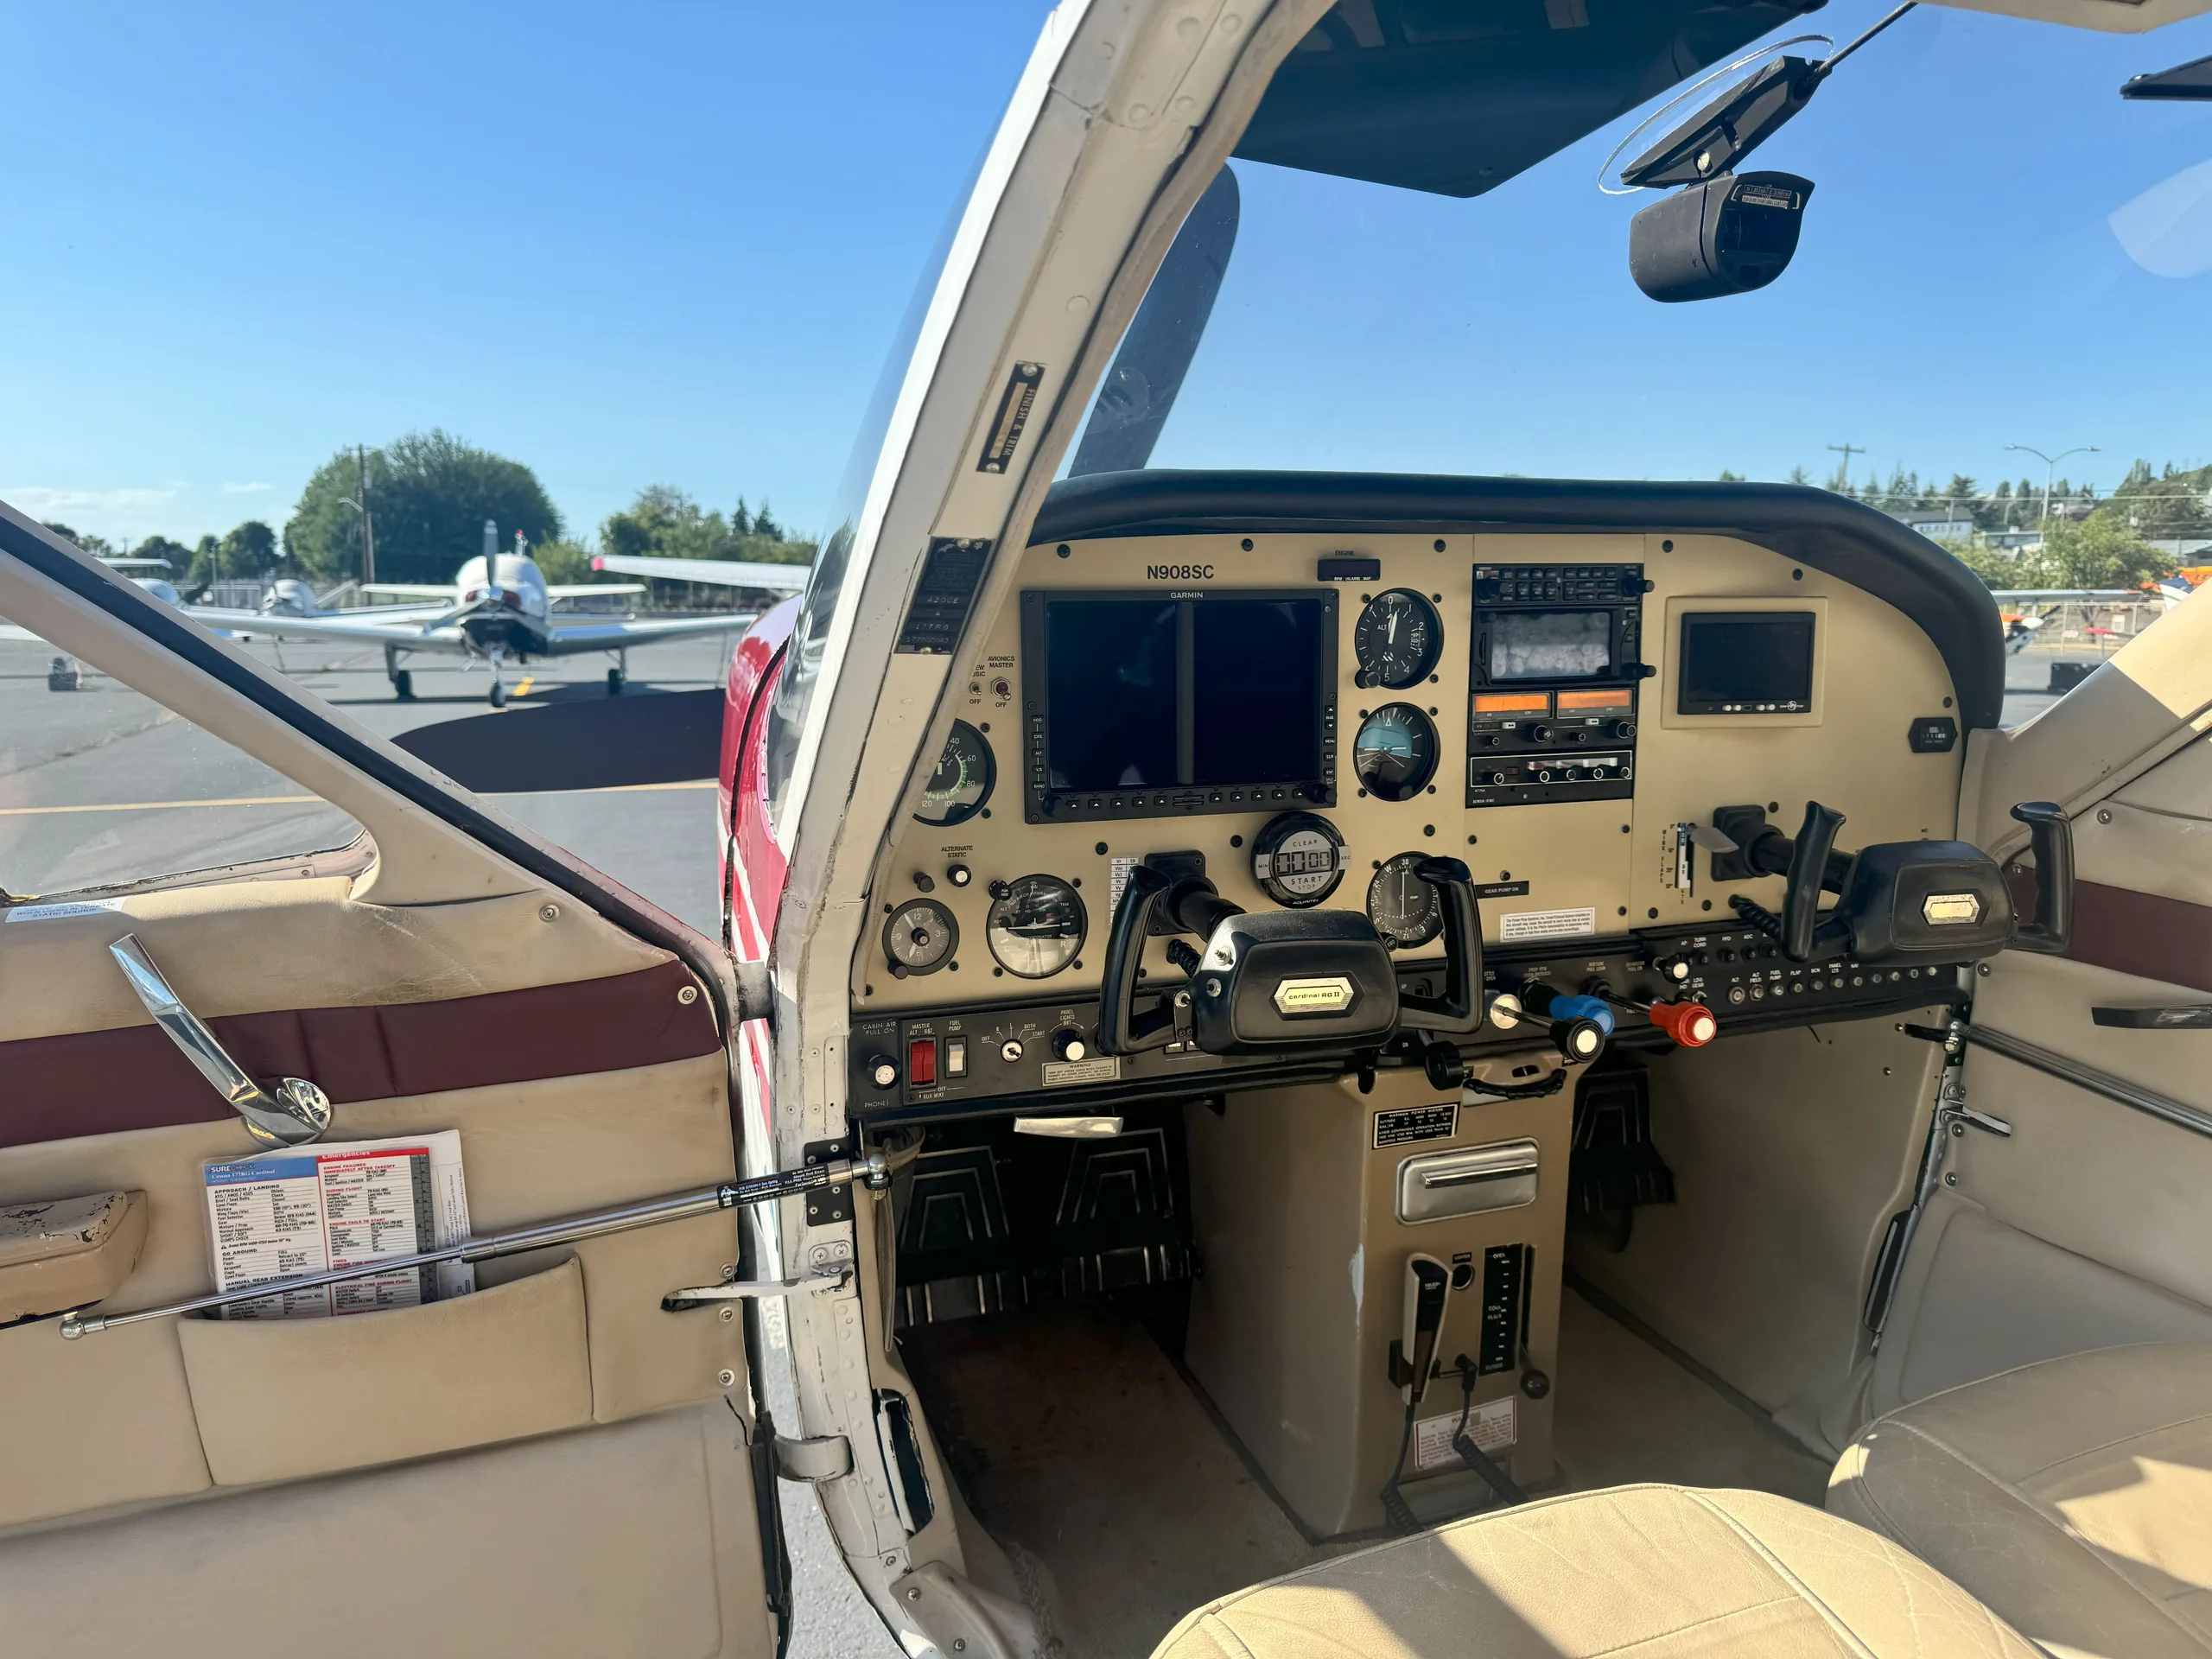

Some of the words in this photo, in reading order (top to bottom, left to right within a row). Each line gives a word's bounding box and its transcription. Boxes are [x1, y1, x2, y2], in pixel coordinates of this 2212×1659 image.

[1017, 388, 1037, 420] FINISH
[1002, 433, 1019, 456] TRIM
[1146, 564, 1214, 582] N908SC
[1418, 622, 1424, 630] 2
[1417, 648, 1423, 656] 3
[1384, 864, 1392, 873] W
[1291, 876, 1322, 885] START
